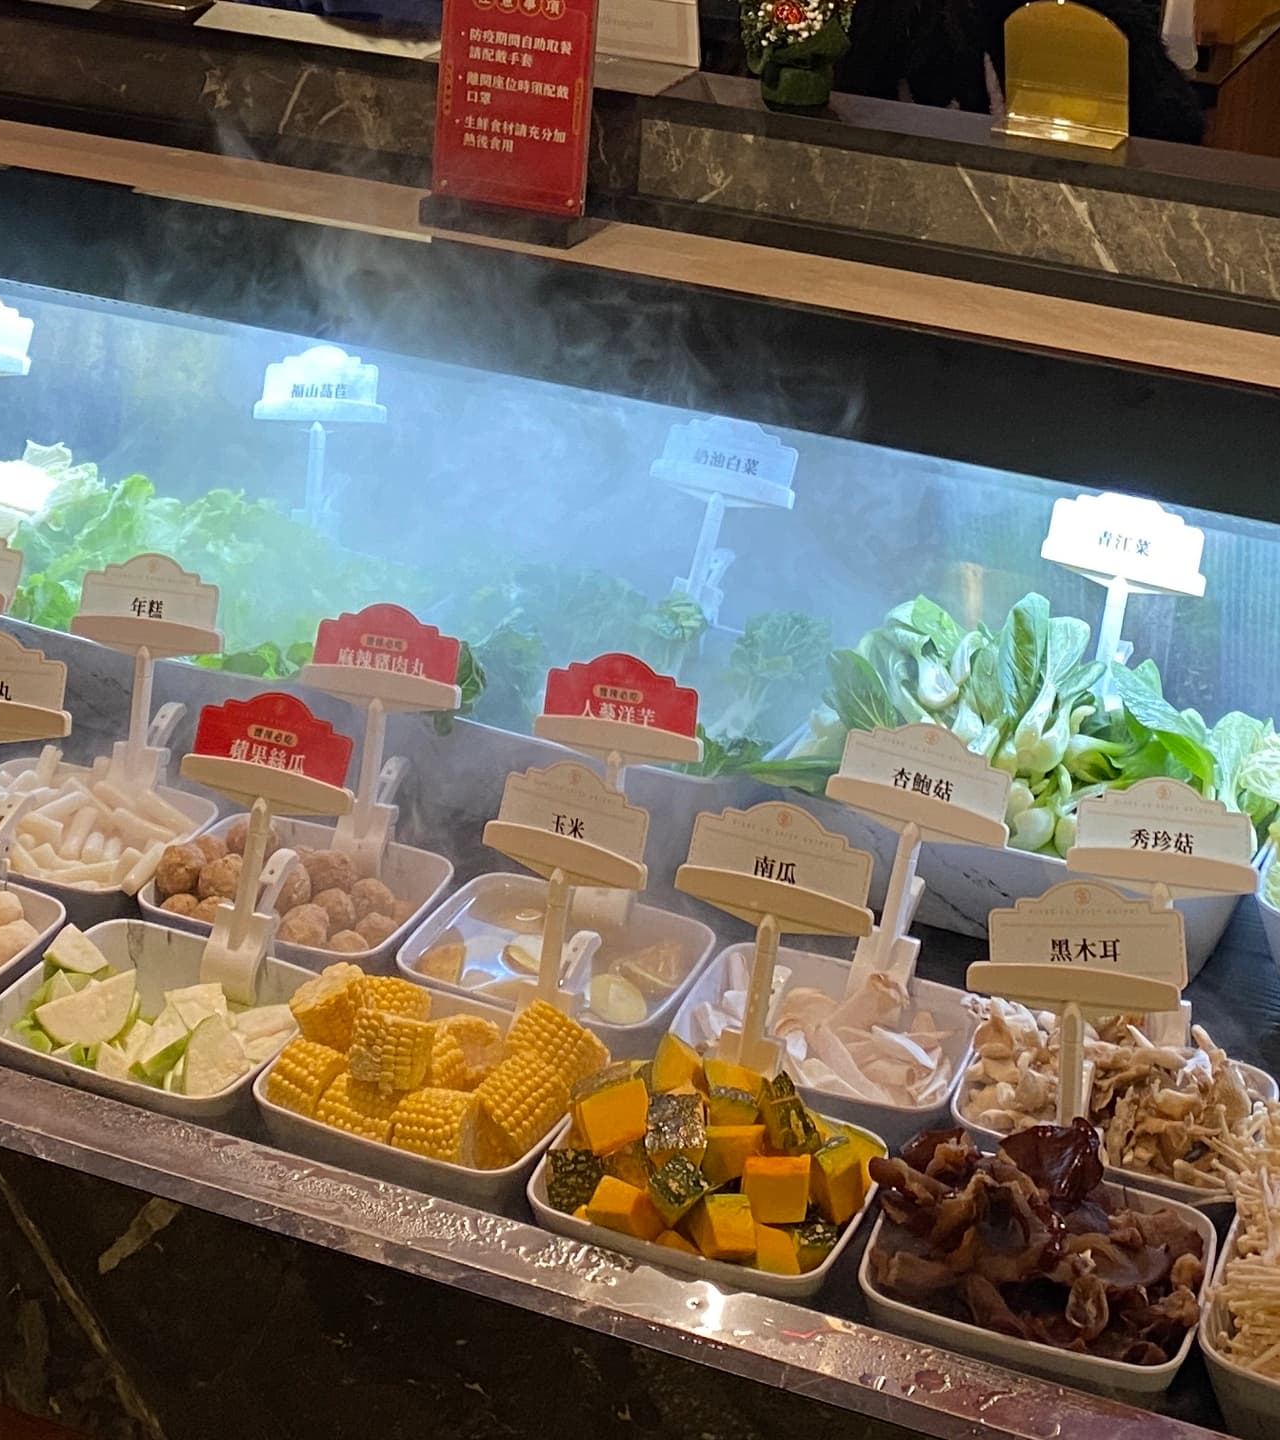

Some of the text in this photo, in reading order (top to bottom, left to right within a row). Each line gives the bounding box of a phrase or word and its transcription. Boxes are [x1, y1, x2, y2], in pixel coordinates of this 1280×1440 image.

[466, 90, 492, 106] 口罩
[463, 115, 567, 144] 生鮮食材請充分加
[463, 132, 515, 154] 熱後食用
[1097, 529, 1151, 558] 青江菜
[129, 596, 164, 620] 年糕
[891, 767, 955, 802] 杏鮑菇
[551, 812, 585, 839] 玉米
[1130, 828, 1195, 855] 秀珍菇
[753, 855, 797, 885] 南瓜
[1049, 938, 1121, 962] 黑木耳
